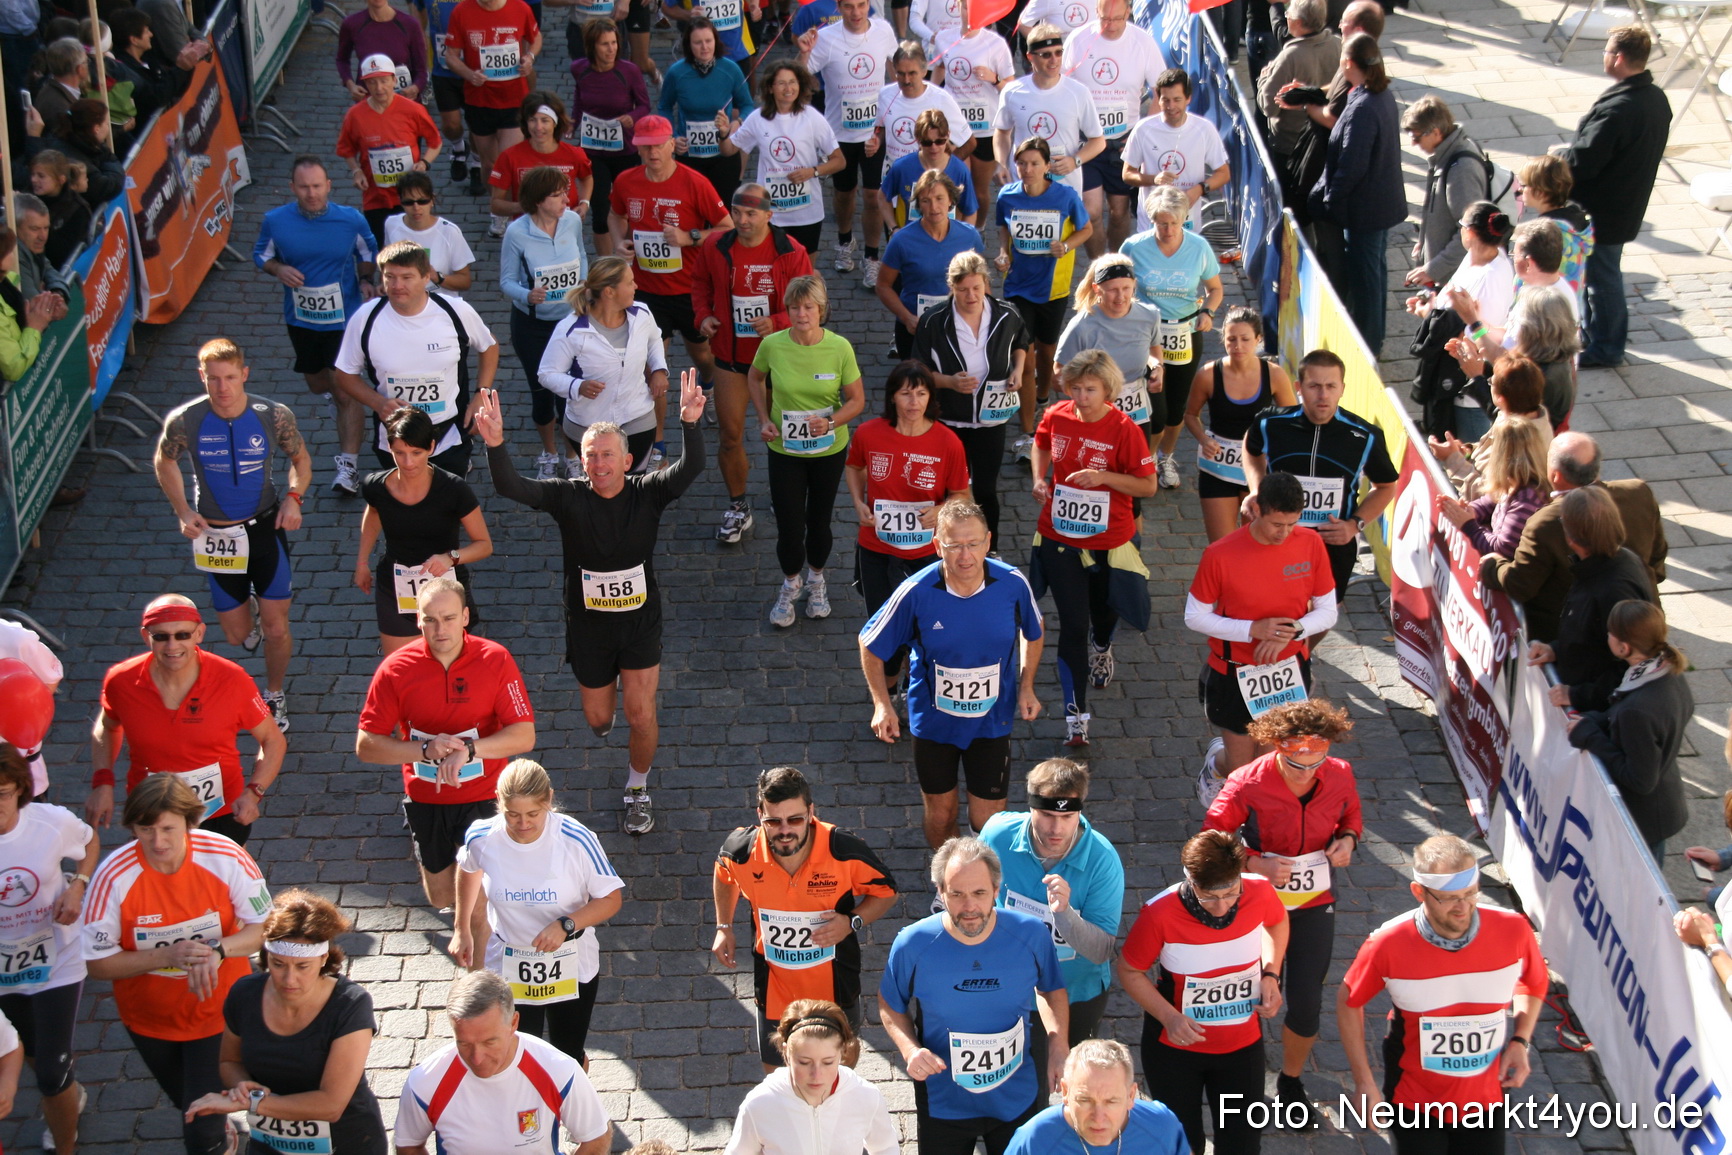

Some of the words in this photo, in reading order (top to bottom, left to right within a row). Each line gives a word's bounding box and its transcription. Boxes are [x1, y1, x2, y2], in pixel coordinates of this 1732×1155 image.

[705, 3, 737, 19] 2132
[485, 53, 517, 68] 2868
[493, 68, 512, 77] Josef
[846, 104, 877, 121] 3040
[585, 123, 618, 141] 3112
[849, 120, 875, 128] Gerhar
[1103, 127, 1115, 135] urt
[378, 158, 405, 174] 635
[770, 182, 806, 199] 2092
[1015, 222, 1054, 239] 2540
[643, 242, 671, 258] 636
[1019, 240, 1050, 250] Brigitte
[648, 259, 668, 268] Sven
[540, 271, 577, 290] 2393
[298, 294, 336, 311] 2921
[302, 310, 336, 319] Michael
[1162, 350, 1187, 360] rigitte
[393, 384, 440, 402] 2723
[36, 391, 56, 437] Action
[415, 403, 431, 412] ich
[990, 409, 1013, 419] Sandra
[788, 423, 818, 439] 24
[802, 440, 817, 449] Ute
[908, 457, 934, 465] STADTLAUF
[910, 453, 941, 462] NEUMARKTER
[1057, 499, 1102, 523] 3029
[881, 512, 925, 531] 219
[1060, 519, 1097, 533] Claudia
[205, 536, 238, 556] 544
[887, 533, 923, 543] Monika
[208, 556, 235, 567] Peter
[1283, 561, 1311, 576] eco
[596, 580, 634, 598] 158
[591, 596, 641, 608] Wolfgang
[1446, 592, 1494, 677] VERKAU
[942, 679, 990, 700] 2121
[1246, 667, 1295, 698] 2062
[953, 700, 983, 711] Peter
[1254, 689, 1296, 710] Michael
[505, 888, 557, 902] heinloth
[16, 910, 32, 919] MIT
[36, 905, 53, 916] HER
[1016, 898, 1045, 916] PFLEIDERER
[137, 914, 162, 925] DAK
[148, 927, 183, 938] PFLEIDERER
[0, 943, 48, 972] 724
[513, 948, 545, 957] PFLEIDERER
[774, 948, 824, 962] Michael
[518, 960, 562, 984] 634
[962, 978, 1000, 987] ERTEL
[525, 985, 555, 997] Jutta
[1192, 979, 1253, 1005] 2609
[1193, 1000, 1253, 1019] Waltraud
[1431, 1028, 1497, 1055] 2607
[961, 1039, 1017, 1073] 2411
[1442, 1054, 1488, 1069] Robert
[973, 1063, 1011, 1086] Stefan
[262, 1133, 316, 1151] Simone
